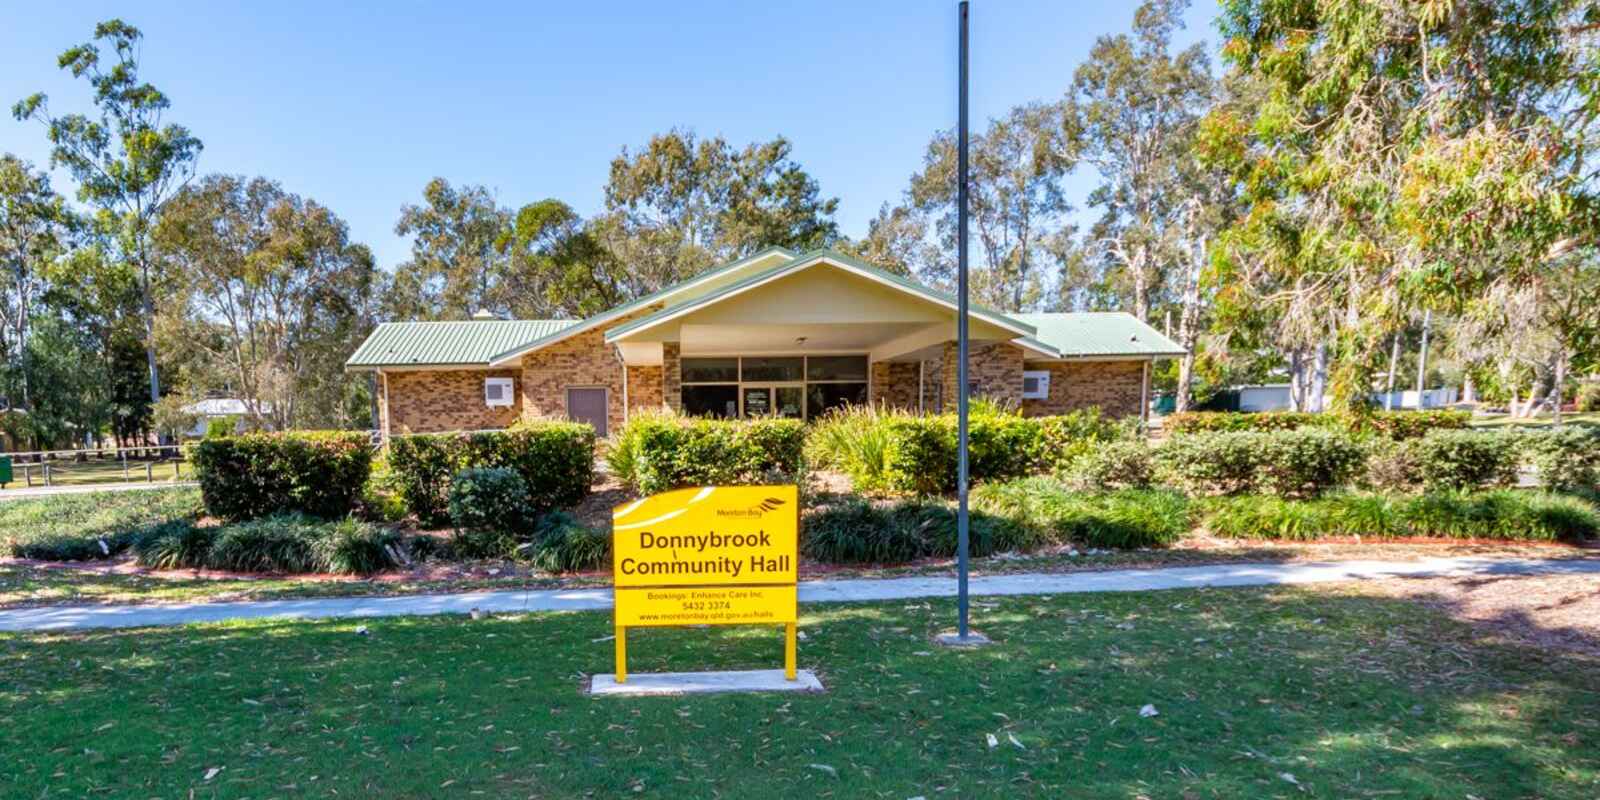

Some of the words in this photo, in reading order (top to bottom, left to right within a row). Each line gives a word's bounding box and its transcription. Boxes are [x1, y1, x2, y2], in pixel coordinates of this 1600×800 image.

[640, 530, 771, 552] Donnybrook
[620, 556, 743, 577] Community
[750, 555, 790, 572] Hall
[647, 592, 687, 601] Bookings:
[691, 591, 726, 599] Enhance
[728, 590, 747, 599] Care
[682, 601, 705, 610] 5432
[708, 601, 731, 609] 3374
